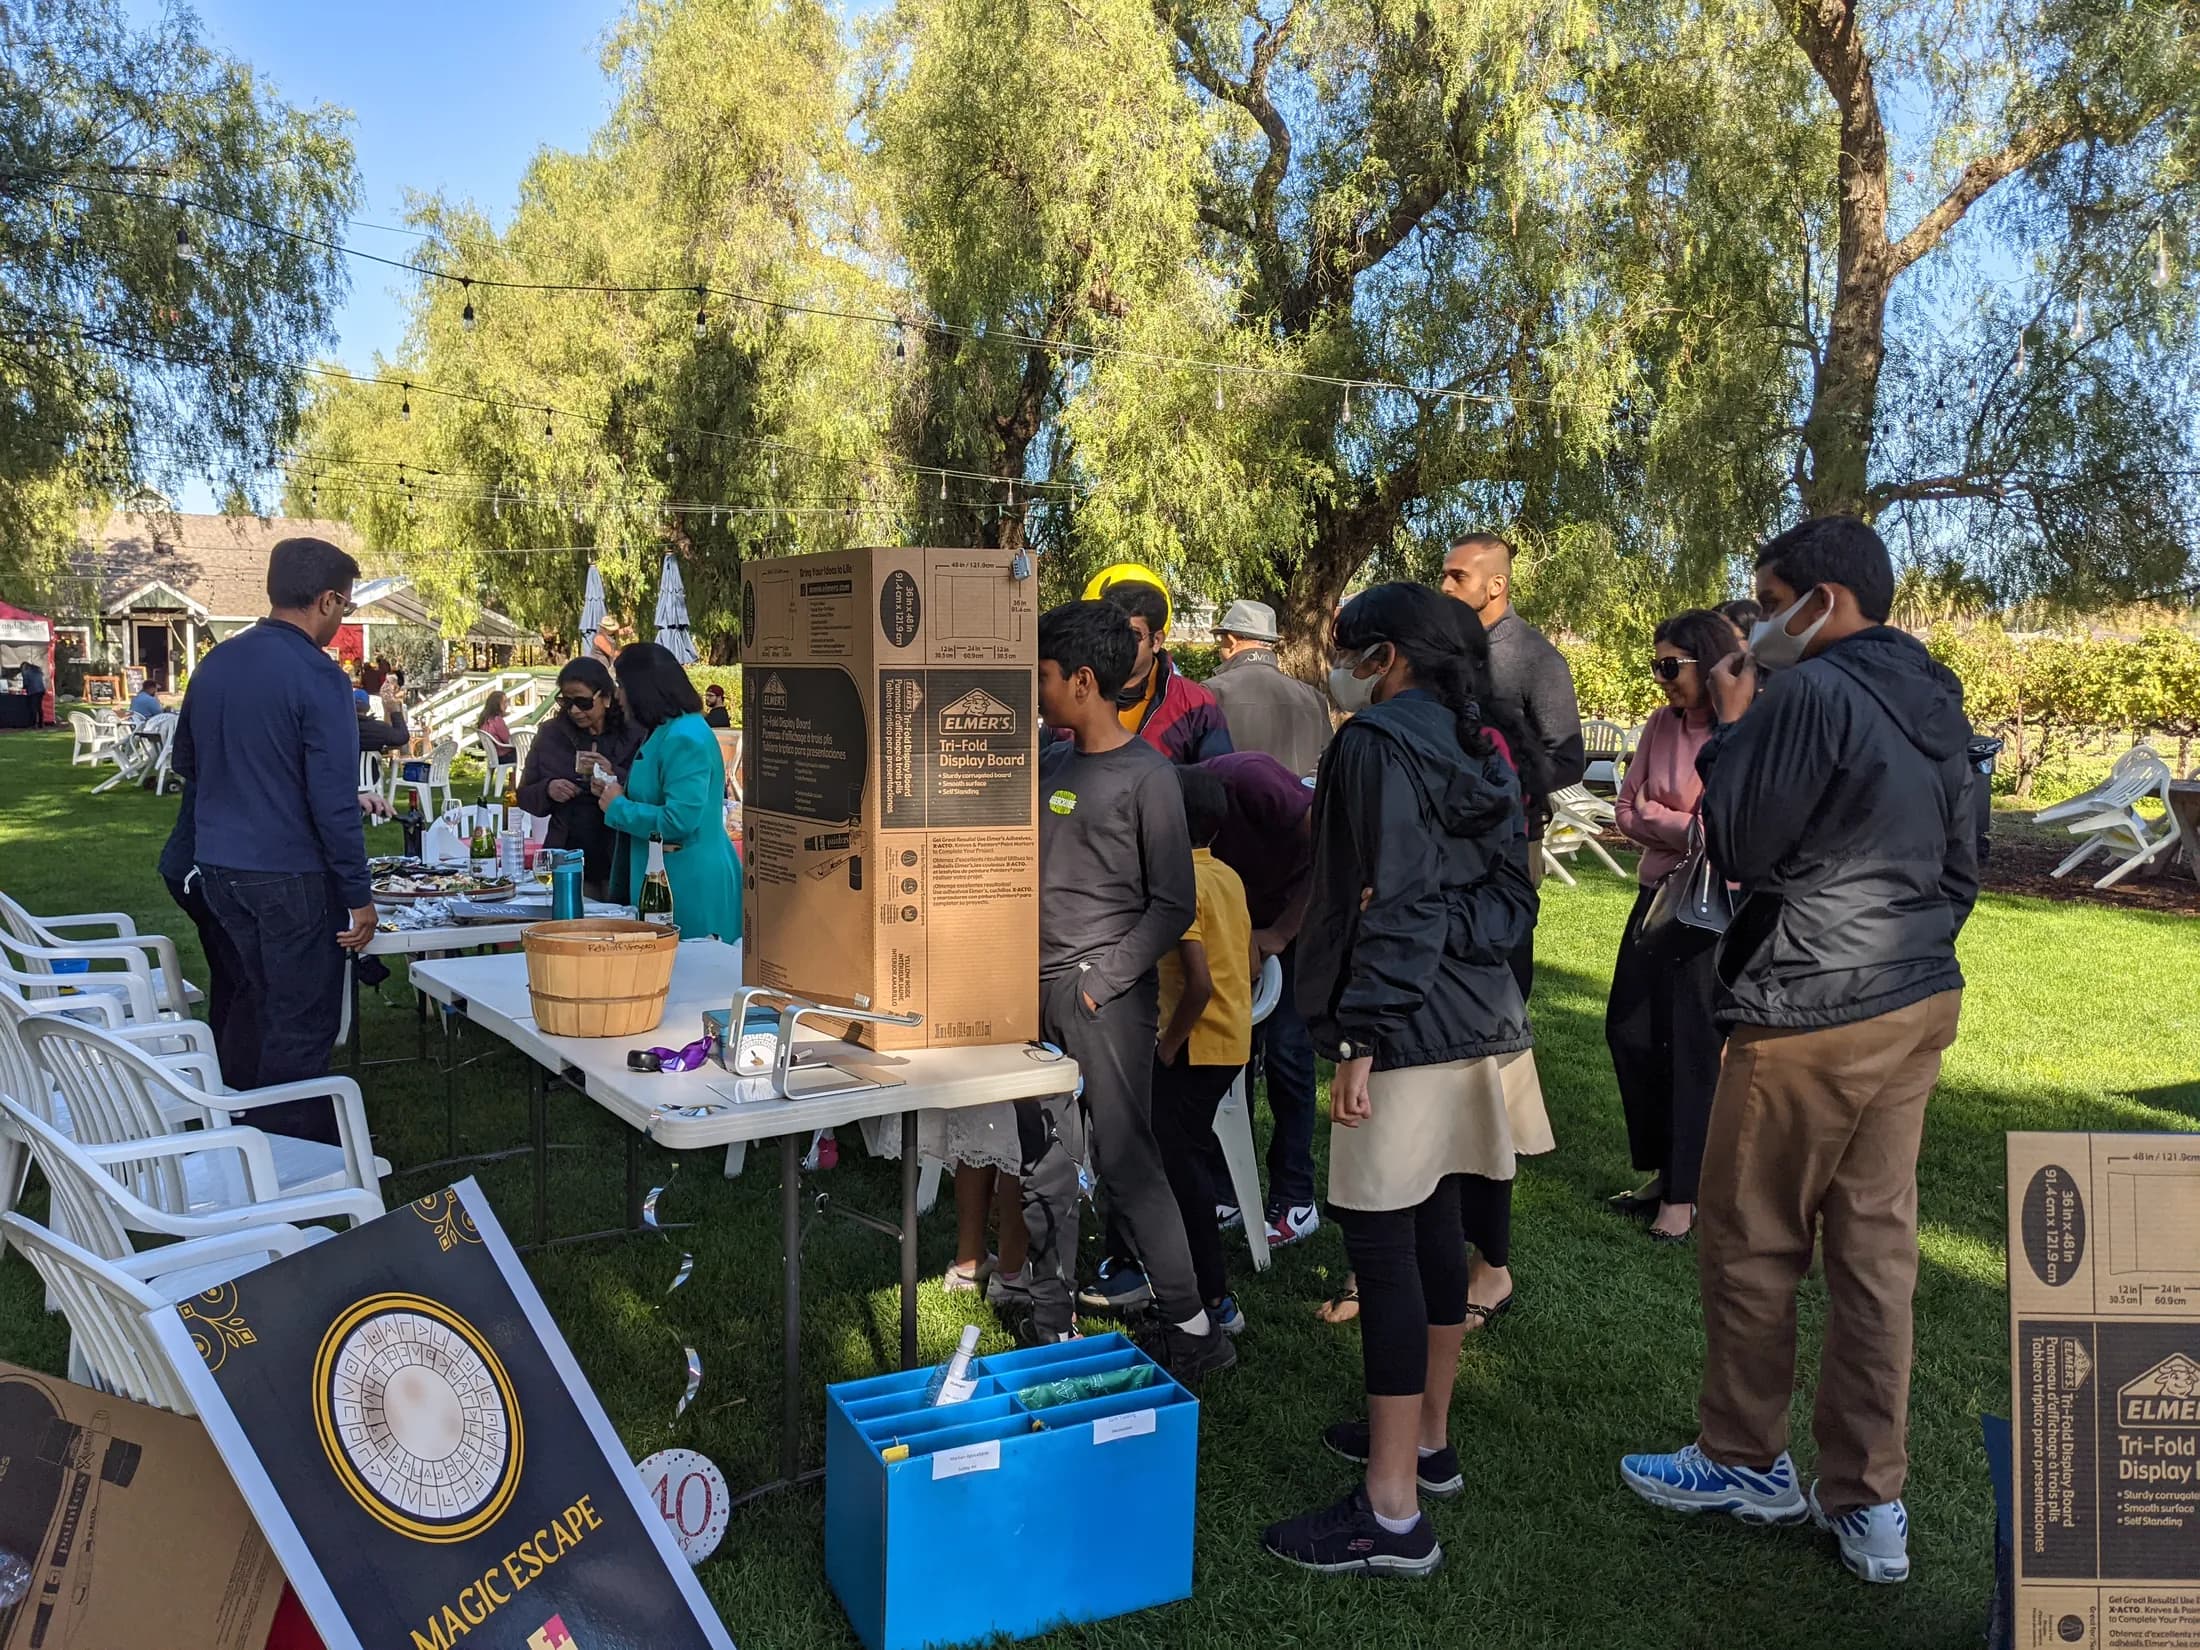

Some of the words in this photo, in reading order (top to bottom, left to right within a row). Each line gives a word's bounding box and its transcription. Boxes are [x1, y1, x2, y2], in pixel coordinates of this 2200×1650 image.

[896, 591, 902, 603] cm
[906, 586, 913, 596] 36
[906, 598, 913, 606] in
[906, 613, 914, 623] 48
[896, 632, 902, 645] cm
[945, 717, 1010, 729] ELMER'S
[894, 714, 903, 755] d'affichage
[939, 740, 987, 751] Tri-Fold
[903, 745, 912, 772] Display
[940, 754, 985, 768] Display
[987, 754, 1024, 766] Board
[885, 756, 894, 813] presentaciones
[2045, 1169, 2056, 1196] 91.4
[2062, 1191, 2074, 1206] 36
[2046, 1199, 2055, 1218] cm
[2062, 1209, 2074, 1221] in
[2047, 1231, 2059, 1261] 121.9
[2063, 1232, 2075, 1249] 48
[2063, 1250, 2075, 1263] in
[2048, 1264, 2056, 1284] cm
[2118, 1285, 2128, 1294] 12
[2130, 1285, 2138, 1294] in
[2161, 1285, 2171, 1293] 24
[2173, 1285, 2181, 1293] in
[2109, 1296, 2125, 1304] 30.5
[2032, 1336, 2044, 1382] Tablero
[2047, 1337, 2058, 1390] Panneau
[2064, 1341, 2074, 1388] ELMER'S
[2046, 1393, 2060, 1459] d'affichage
[2061, 1393, 2074, 1440] Tri-Fold
[2032, 1429, 2043, 1457] para
[2118, 1435, 2195, 1456] Tri-Fold
[2061, 1443, 2074, 1488] Display
[2120, 1460, 2192, 1484] Display
[2048, 1472, 2060, 1499] trois
[2124, 1490, 2154, 1501] Sturdy
[2032, 1460, 2046, 1552] presentaciones
[2047, 1501, 2060, 1522] plis
[2062, 1490, 2075, 1527] Board
[2124, 1504, 2160, 1513] Smooth
[2161, 1504, 2194, 1513] surface
[2124, 1516, 2142, 1526] Self
[2143, 1516, 2182, 1527] Standing
[409, 1568, 512, 1650] MAGIC
[501, 1494, 604, 1591] ESCAPE
[2119, 1616, 2156, 1624] Complete
